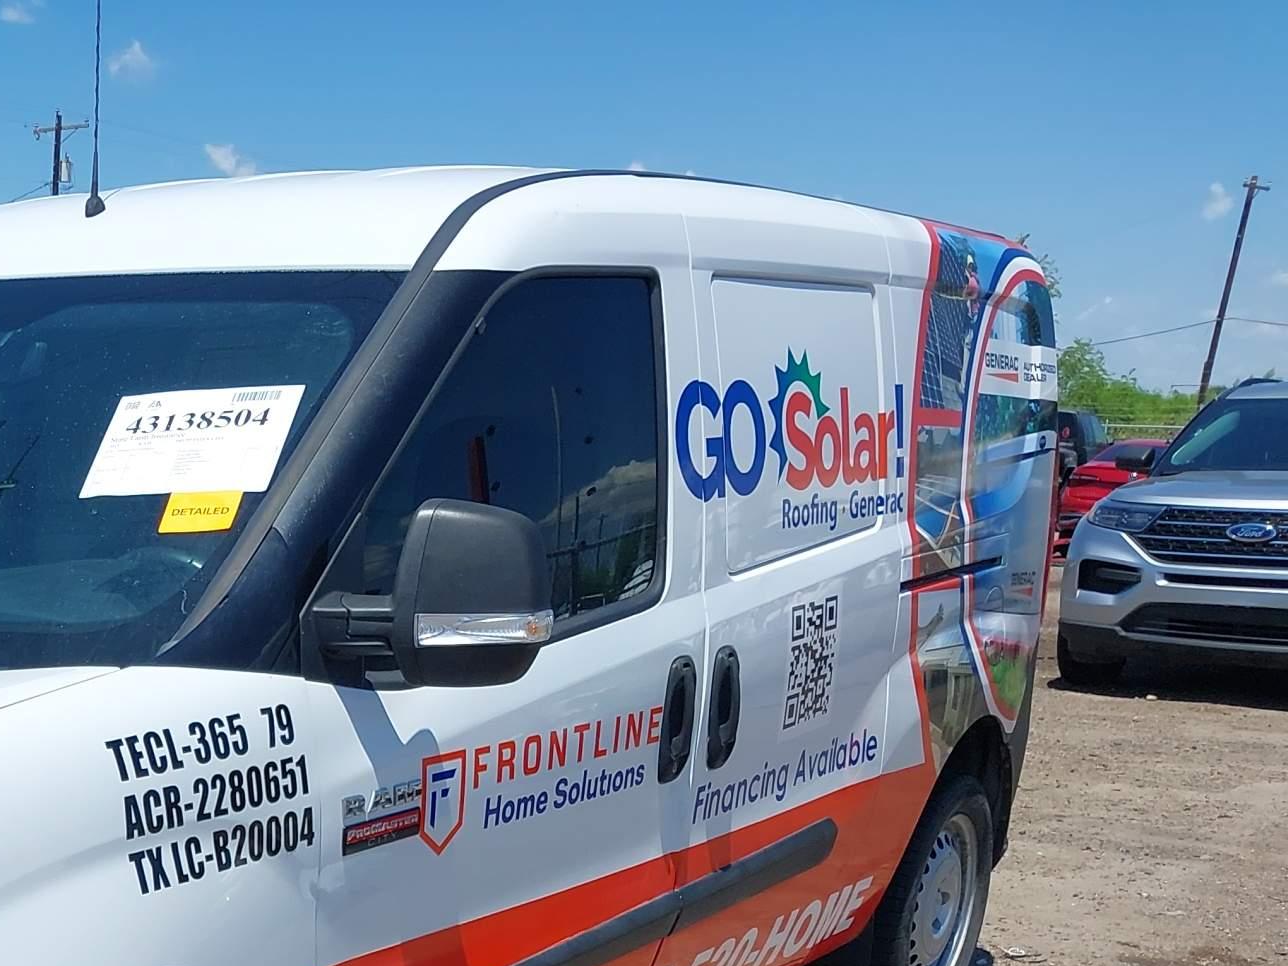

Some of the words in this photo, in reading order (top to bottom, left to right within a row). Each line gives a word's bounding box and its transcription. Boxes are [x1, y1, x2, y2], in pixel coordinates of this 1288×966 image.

[985, 353, 1019, 371] GENERAC
[125, 407, 271, 434] 43138504
[675, 379, 766, 502] GO
[785, 384, 904, 491] Solar!
[171, 506, 230, 517] DETAILED
[782, 493, 838, 531] Roofing
[849, 490, 904, 518] Generac
[105, 713, 249, 781] TECL-365
[260, 704, 295, 748] 79
[473, 706, 663, 789] FRONTLINE
[692, 761, 789, 825] Financing
[793, 729, 878, 786] Available
[124, 755, 309, 840] ACR-2280651
[483, 794, 547, 829] Home
[553, 764, 645, 809] Solutions
[128, 846, 171, 894] TX
[171, 807, 315, 884] LC-B20004
